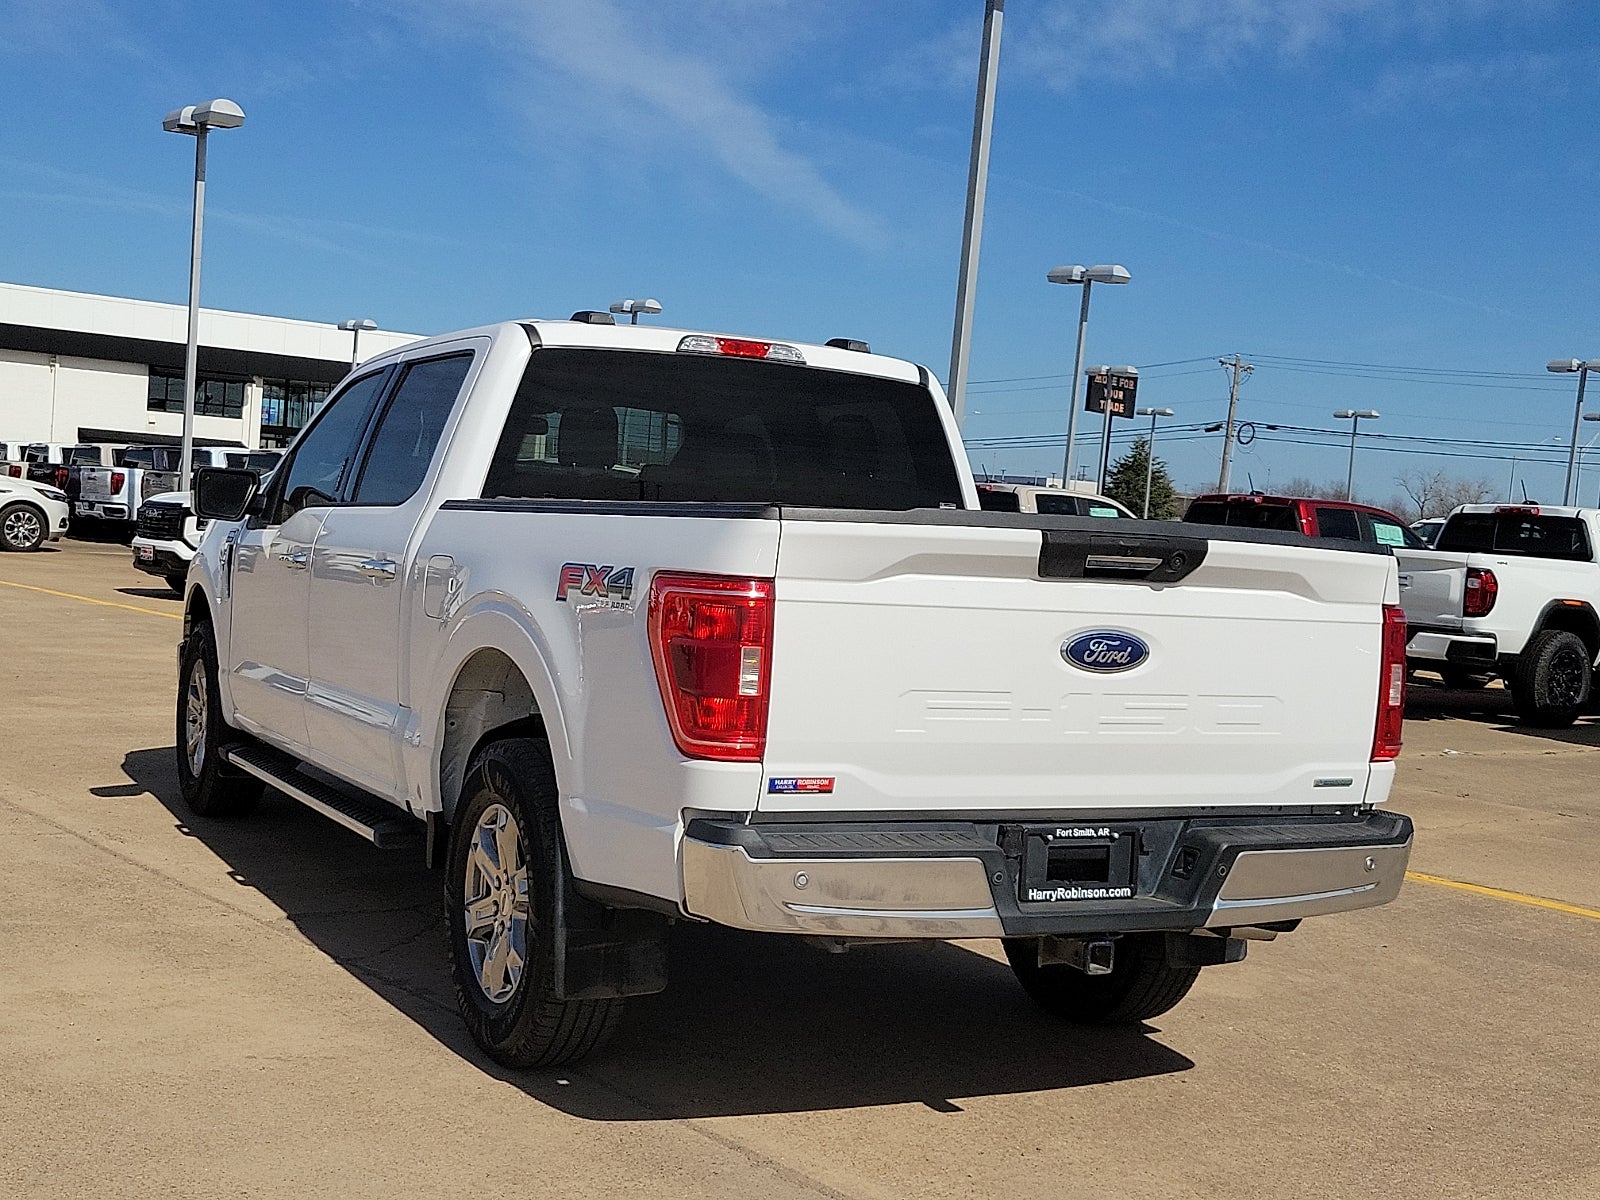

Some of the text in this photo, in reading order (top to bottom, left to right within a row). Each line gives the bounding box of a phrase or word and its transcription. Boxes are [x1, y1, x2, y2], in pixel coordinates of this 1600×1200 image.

[1094, 374, 1135, 389] MOE FOR
[1103, 388, 1124, 399] YUR
[1099, 400, 1124, 412] TADE
[555, 562, 635, 602] FX4
[1083, 638, 1133, 664] Ford
[1056, 828, 1110, 837] Fort Smith, AR
[1028, 887, 1131, 901] HarryRobinson.com
